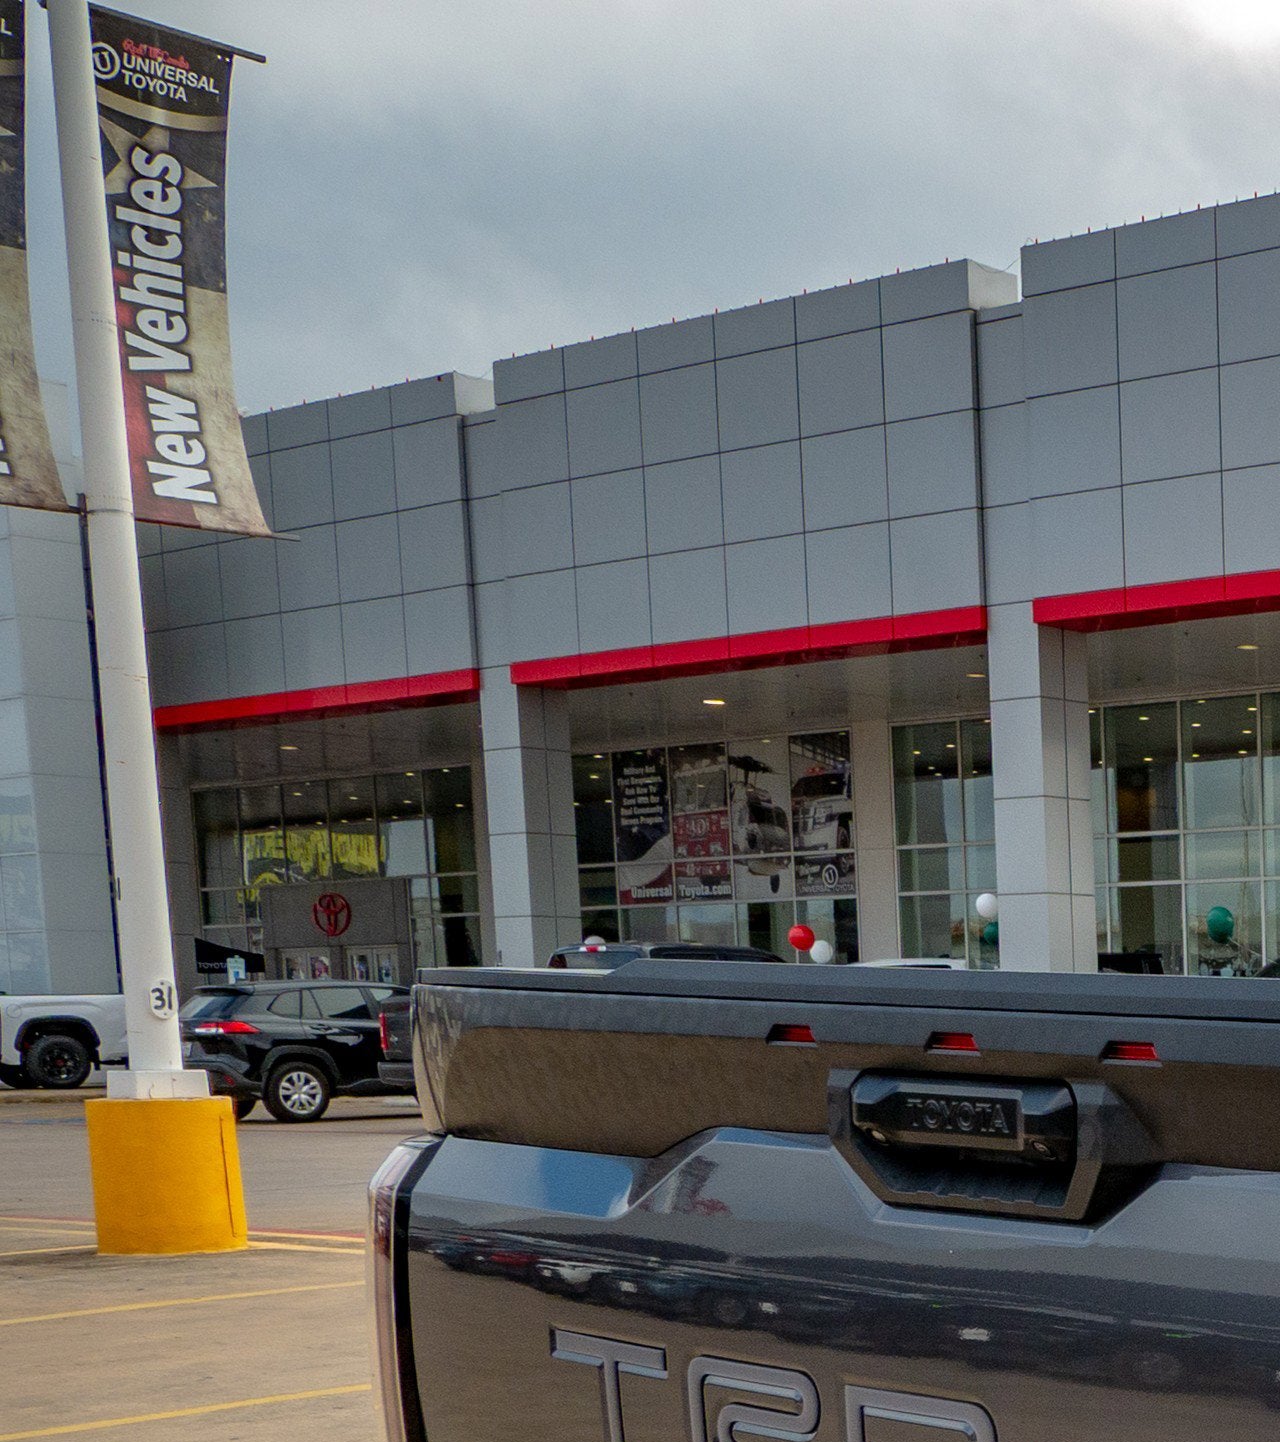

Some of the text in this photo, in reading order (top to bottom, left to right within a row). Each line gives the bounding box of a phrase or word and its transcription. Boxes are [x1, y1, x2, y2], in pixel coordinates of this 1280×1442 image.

[121, 69, 188, 103] TOYOTA
[122, 51, 220, 95] UNIVERSAL
[115, 146, 217, 504] New Vehicles
[631, 884, 732, 899] Universal Toyota.com
[151, 985, 173, 1010] 31
[905, 1098, 1010, 1135] TOYOTA
